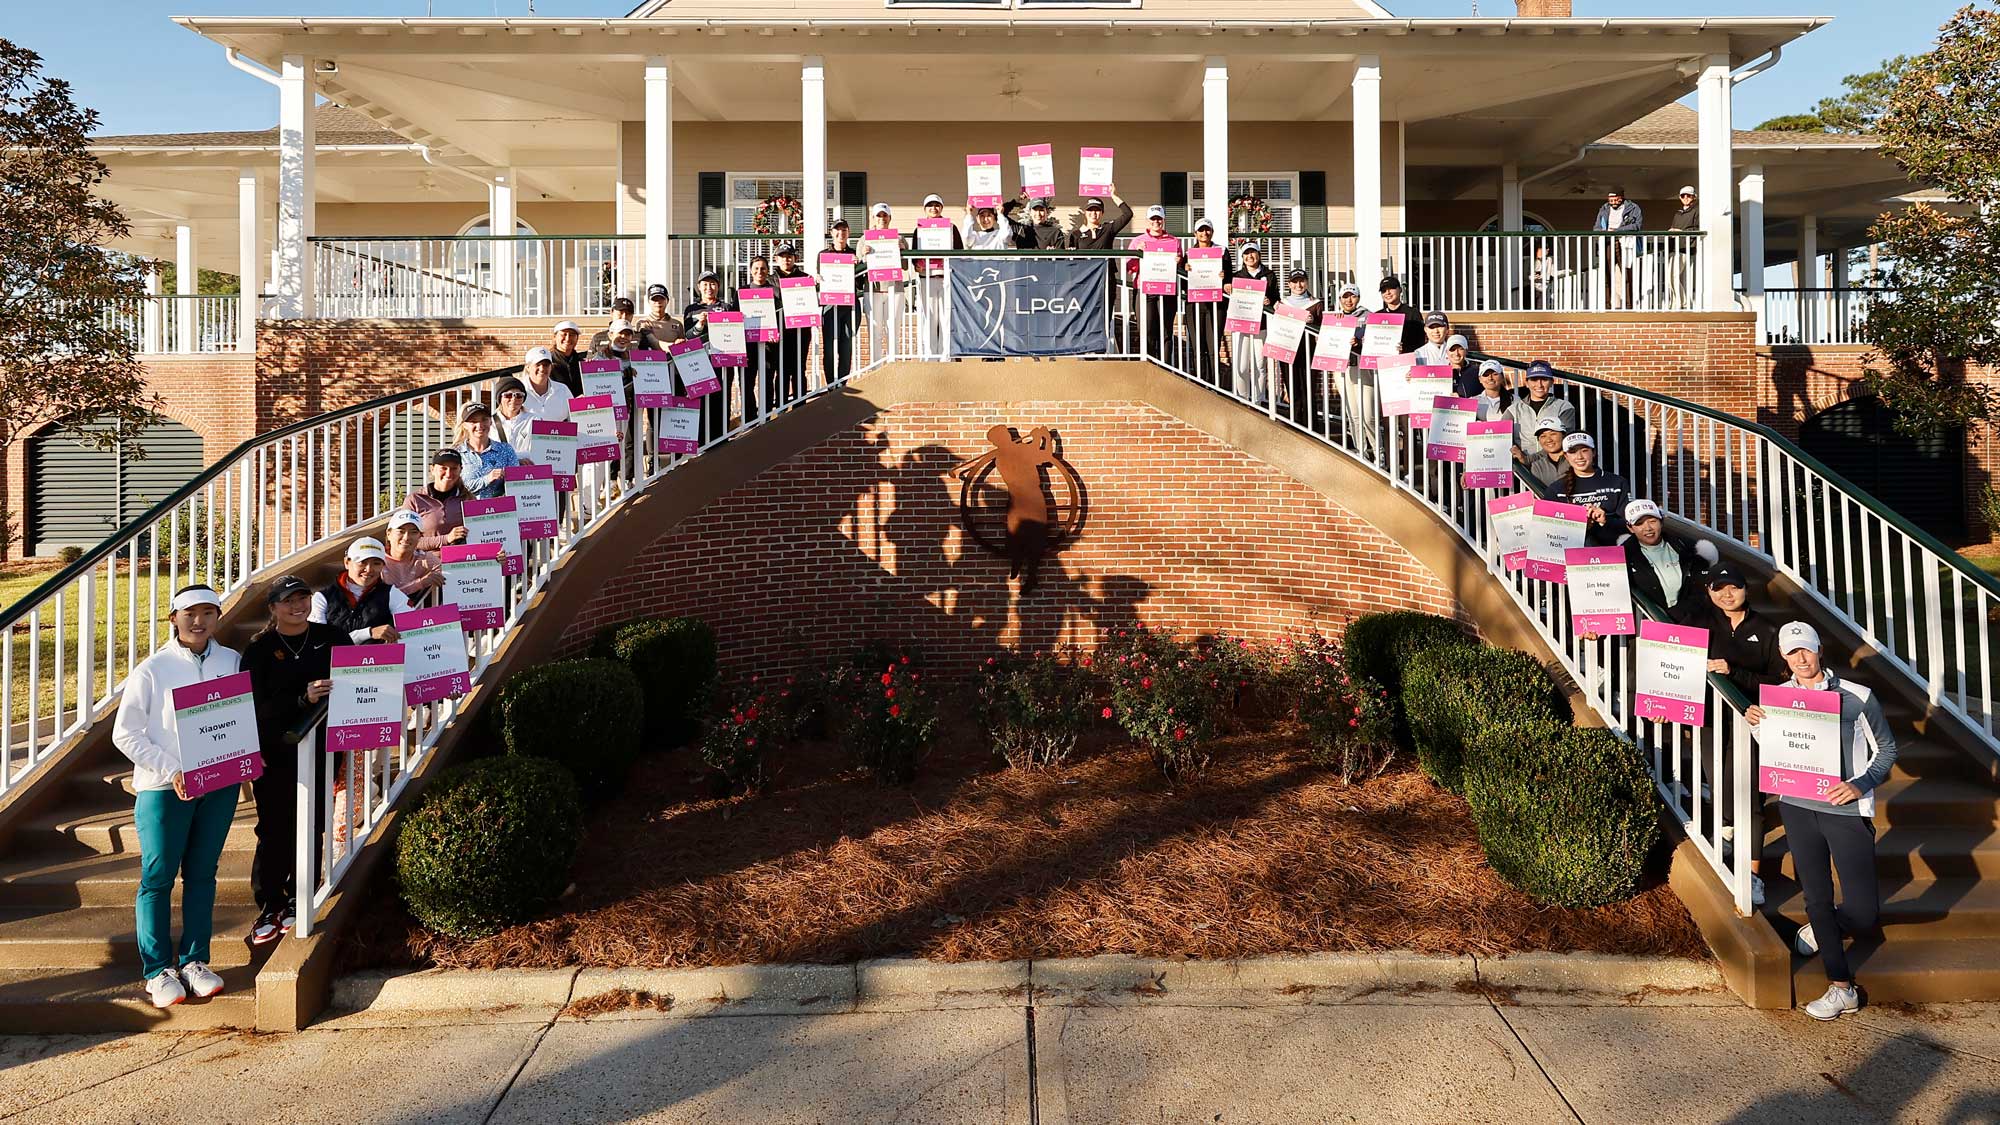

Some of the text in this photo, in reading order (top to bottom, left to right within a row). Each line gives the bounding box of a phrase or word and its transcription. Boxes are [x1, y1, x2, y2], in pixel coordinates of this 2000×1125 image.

[1016, 298, 1082, 314] LPGA
[1546, 532, 1568, 541] Yealimi
[422, 618, 433, 626] AA
[1667, 634, 1679, 643] AA
[423, 643, 441, 653] Kelly
[431, 667, 456, 676] MEMBER
[1660, 661, 1684, 672] Robyn
[451, 676, 462, 684] 20
[1663, 671, 1680, 680] Choi
[206, 690, 221, 701] AA
[1665, 691, 1691, 700] MEMBER
[187, 705, 208, 715] INSIDE
[221, 697, 241, 706] ROPES
[1684, 704, 1695, 713] 20
[1792, 700, 1805, 709] AA
[1683, 712, 1694, 720] 24
[198, 720, 236, 734] Xiaowen
[211, 731, 226, 742] Yin
[1782, 729, 1816, 740] Laetitia
[1788, 740, 1809, 750] Beck
[197, 748, 245, 767] LPGA MEMBER
[238, 758, 252, 768] 20
[1793, 763, 1824, 773] MEMBER
[240, 766, 252, 776] 24
[1816, 778, 1829, 787] 20
